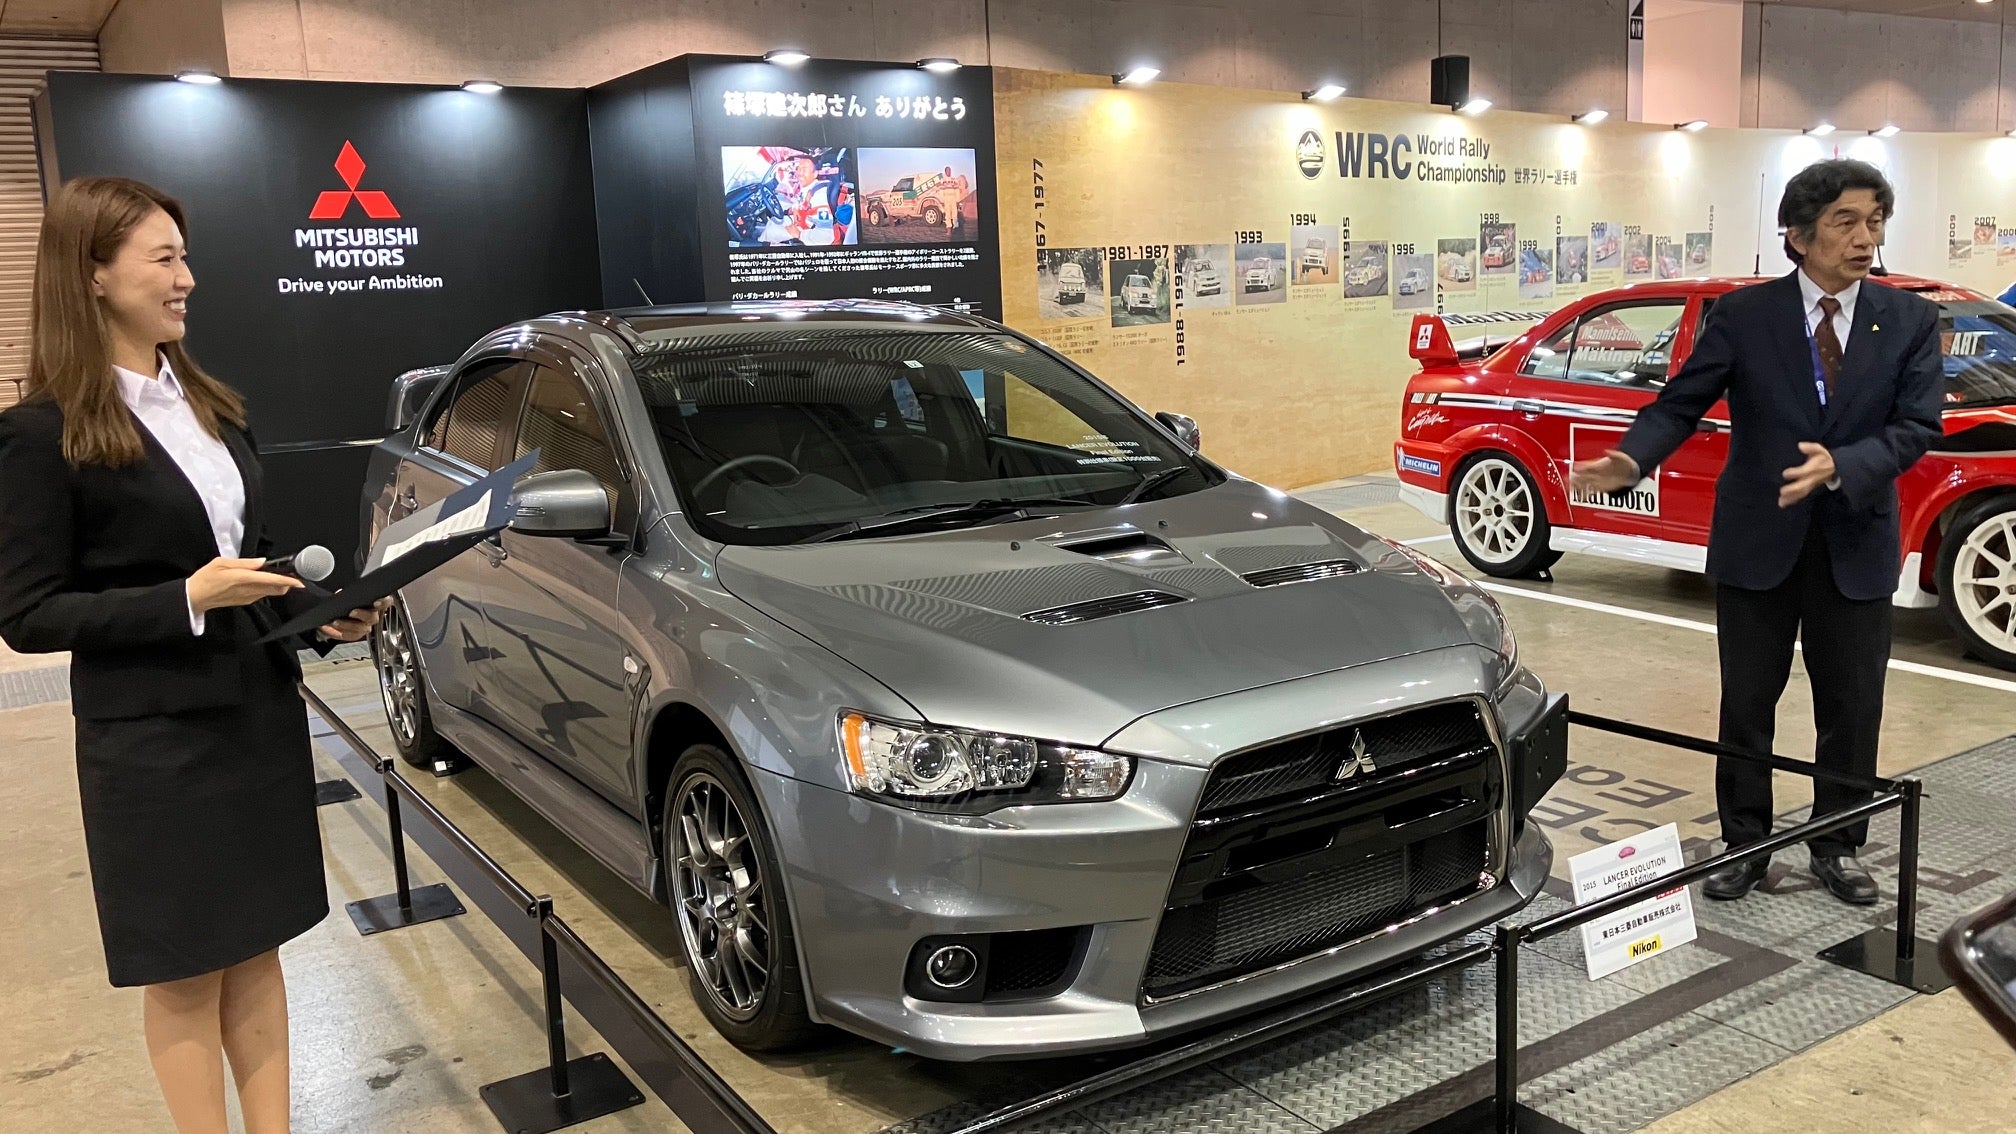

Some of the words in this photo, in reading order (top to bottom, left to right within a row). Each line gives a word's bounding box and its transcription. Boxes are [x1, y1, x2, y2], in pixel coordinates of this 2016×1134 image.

[875, 95, 967, 120] ありがとう
[1417, 134, 1455, 156] World
[1459, 138, 1490, 160] Rally
[1335, 131, 1412, 180] WRC
[1417, 160, 1506, 185] Championship
[1514, 167, 1577, 185] 世界ラリー選手権
[1290, 213, 1317, 226] 1994
[1479, 213, 1500, 224] 1998
[1974, 216, 1996, 226] 2007
[1591, 222, 1608, 232] 2001
[1624, 226, 1641, 235] 2002
[1997, 228, 2016, 237] 200
[295, 227, 419, 247] MITSUBISHI
[1234, 230, 1263, 244] 1993
[1519, 240, 1538, 250] 1999
[1656, 236, 1671, 246] 2004
[1102, 245, 1169, 260] 1981-1987
[1392, 243, 1415, 255] 1996
[314, 248, 405, 268] MOTORS
[278, 278, 324, 293] Drive
[327, 279, 365, 295] your
[368, 274, 443, 290] Ambition
[1174, 262, 1185, 366] 1988-1992
[1405, 458, 1439, 472] MICHELIN
[1582, 880, 1597, 891] 2015
[1603, 870, 1629, 885] LANCER
[1630, 856, 1667, 878] EVOLUTION
[1617, 879, 1635, 892] Final
[1634, 871, 1657, 886] Edition
[1632, 939, 1657, 957] Nikon
